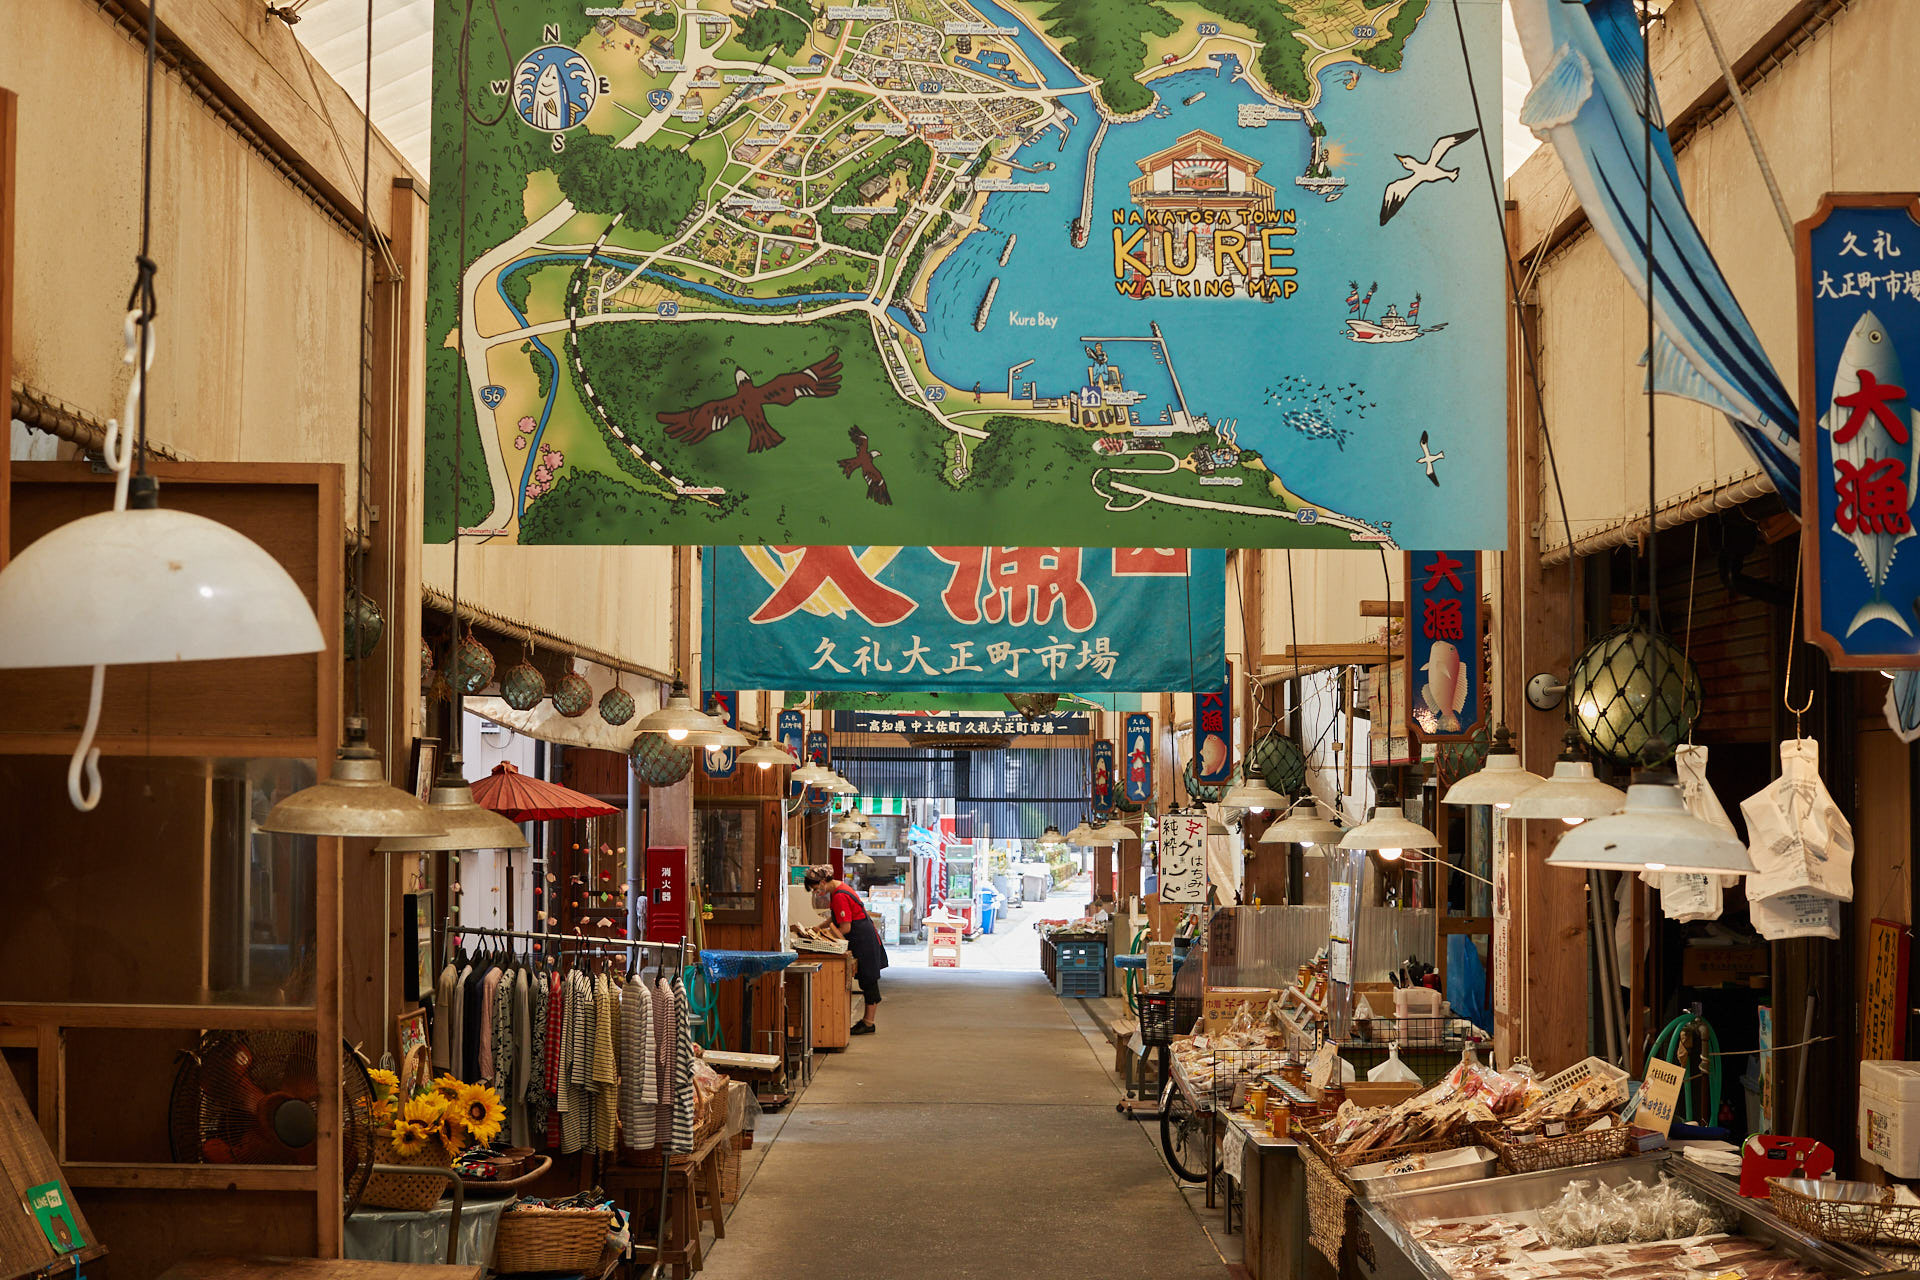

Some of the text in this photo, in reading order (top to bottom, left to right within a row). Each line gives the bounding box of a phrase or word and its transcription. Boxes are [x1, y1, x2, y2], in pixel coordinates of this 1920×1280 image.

[544, 25, 559, 42] N
[1200, 24, 1216, 35] 320
[1356, 27, 1372, 38] 320
[492, 81, 508, 94] W
[599, 77, 609, 93] E
[922, 84, 938, 92] 320
[652, 92, 668, 105] 56
[552, 135, 565, 151] S
[1112, 209, 1297, 225] NAKATOSA TOWN
[1112, 226, 1298, 279] KURE
[1838, 229, 1902, 260] 久礼
[1116, 279, 1298, 298] WALKING MAP
[1816, 269, 1920, 302] 大正町市場
[660, 304, 675, 315] 25
[1009, 312, 1058, 329] Kure Bay
[484, 389, 500, 401] 56
[928, 387, 943, 400] 25
[1833, 369, 1912, 536] 大漁
[1300, 509, 1315, 522] 25
[1422, 550, 1465, 641] 大漁
[809, 635, 1121, 681] 久礼大正町市場
[911, 721, 961, 733] 中土佐町
[1131, 748, 1147, 783] 大漁
[661, 867, 672, 902] 消火器
[33, 1196, 49, 1209] LINE
